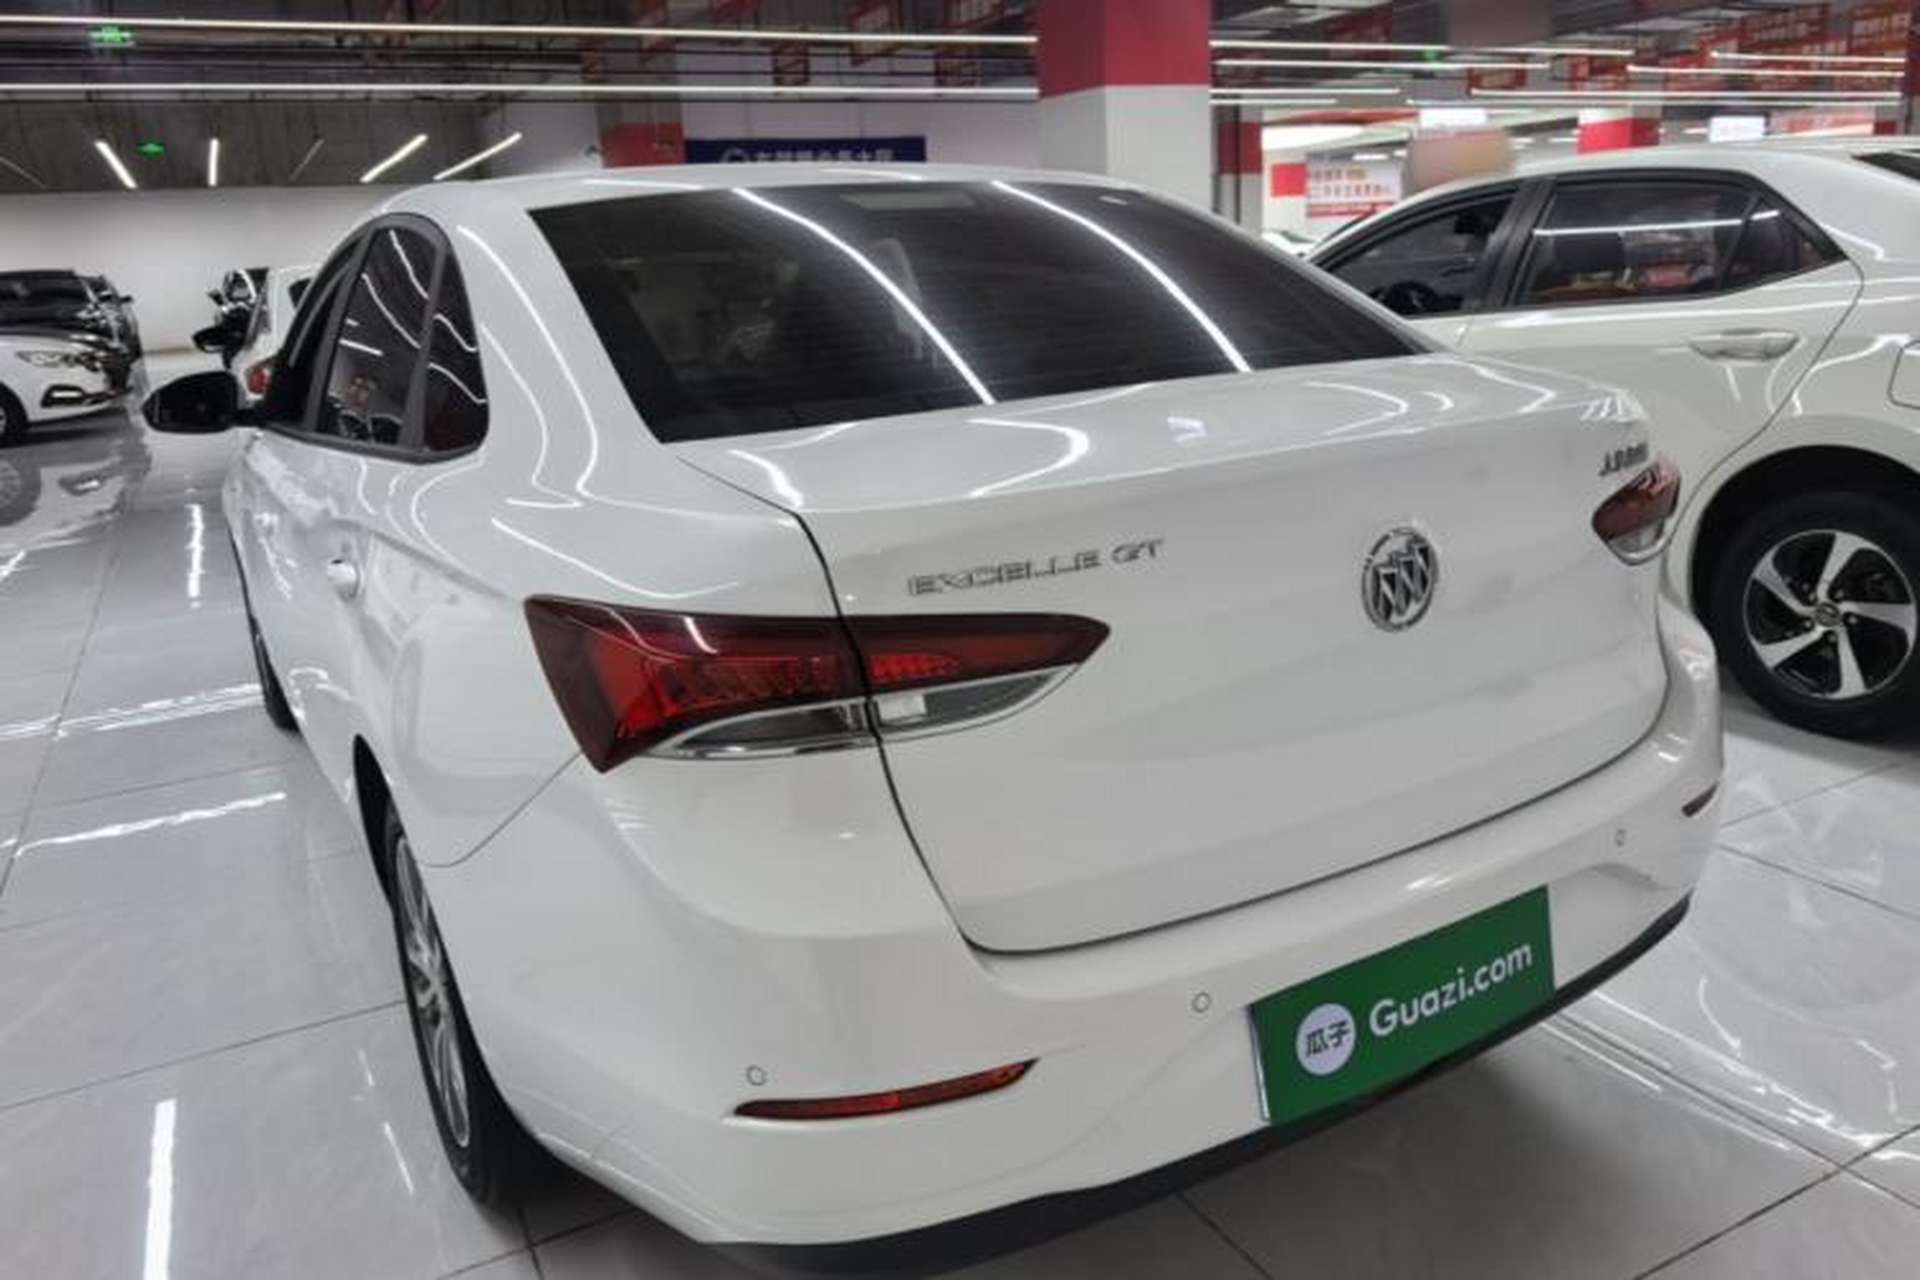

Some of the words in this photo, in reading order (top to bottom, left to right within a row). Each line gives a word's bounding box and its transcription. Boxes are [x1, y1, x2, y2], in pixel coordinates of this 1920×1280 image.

[907, 549, 1103, 597] EXCELLE
[1111, 537, 1165, 564] GT
[1368, 943, 1533, 1038] Guazi.com
[1304, 1020, 1352, 1059] 瓜子
